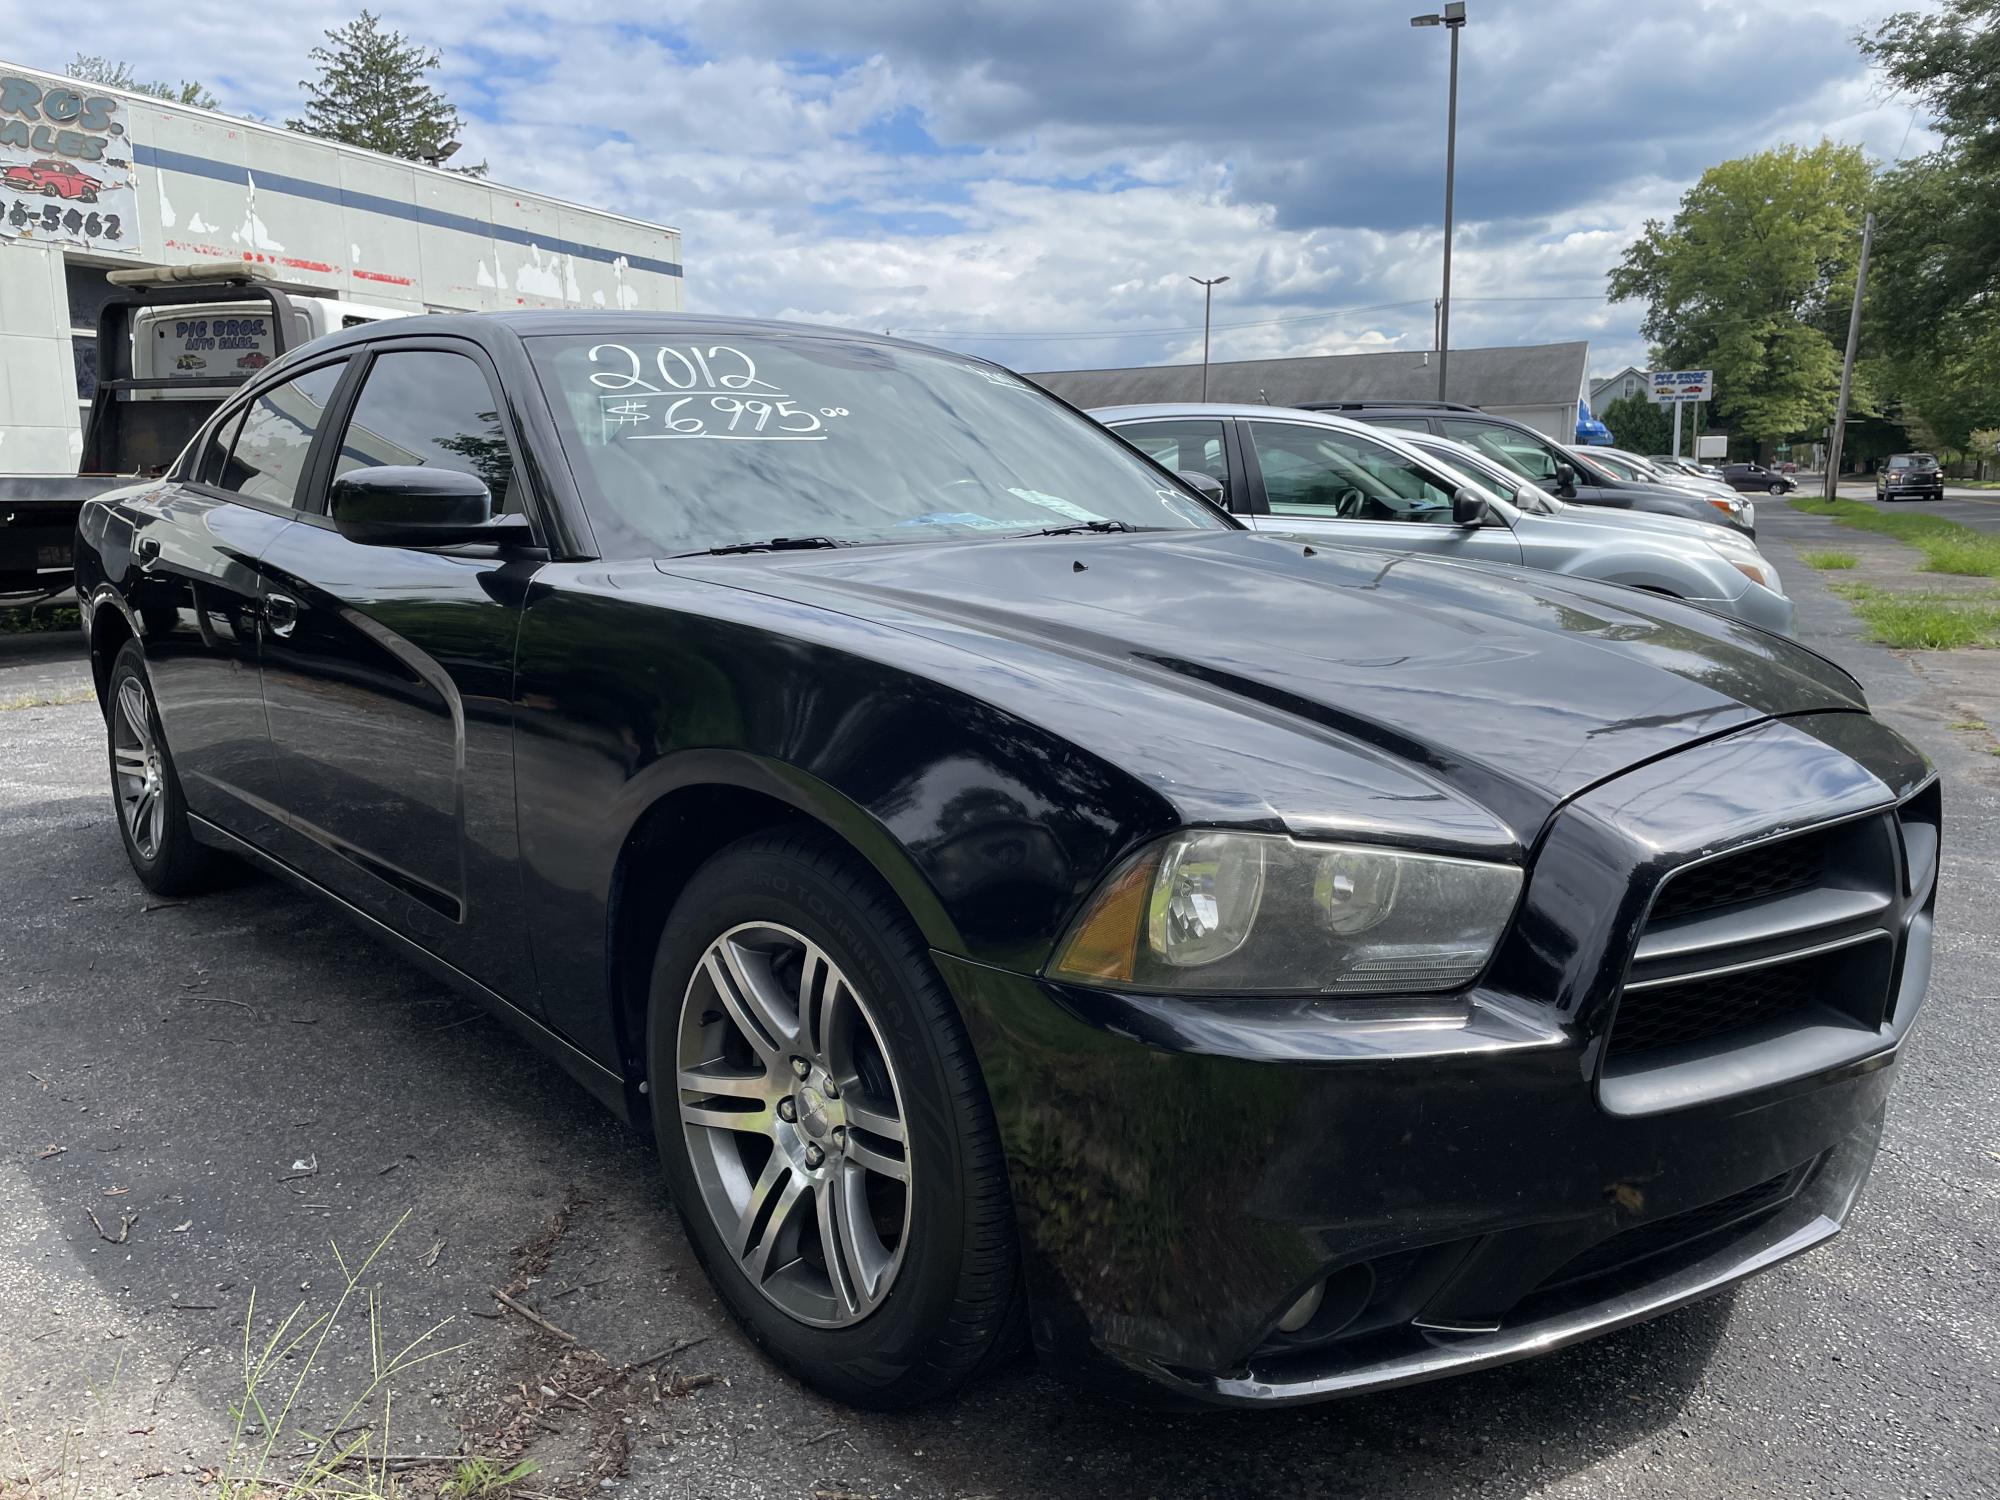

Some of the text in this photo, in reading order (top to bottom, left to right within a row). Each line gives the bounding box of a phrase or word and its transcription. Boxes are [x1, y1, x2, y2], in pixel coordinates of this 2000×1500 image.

[0, 118, 108, 161] ALES
[185, 337, 215, 350] AUTO
[219, 336, 252, 350] SALES
[213, 319, 267, 337] BROS.
[588, 343, 781, 391] 2012
